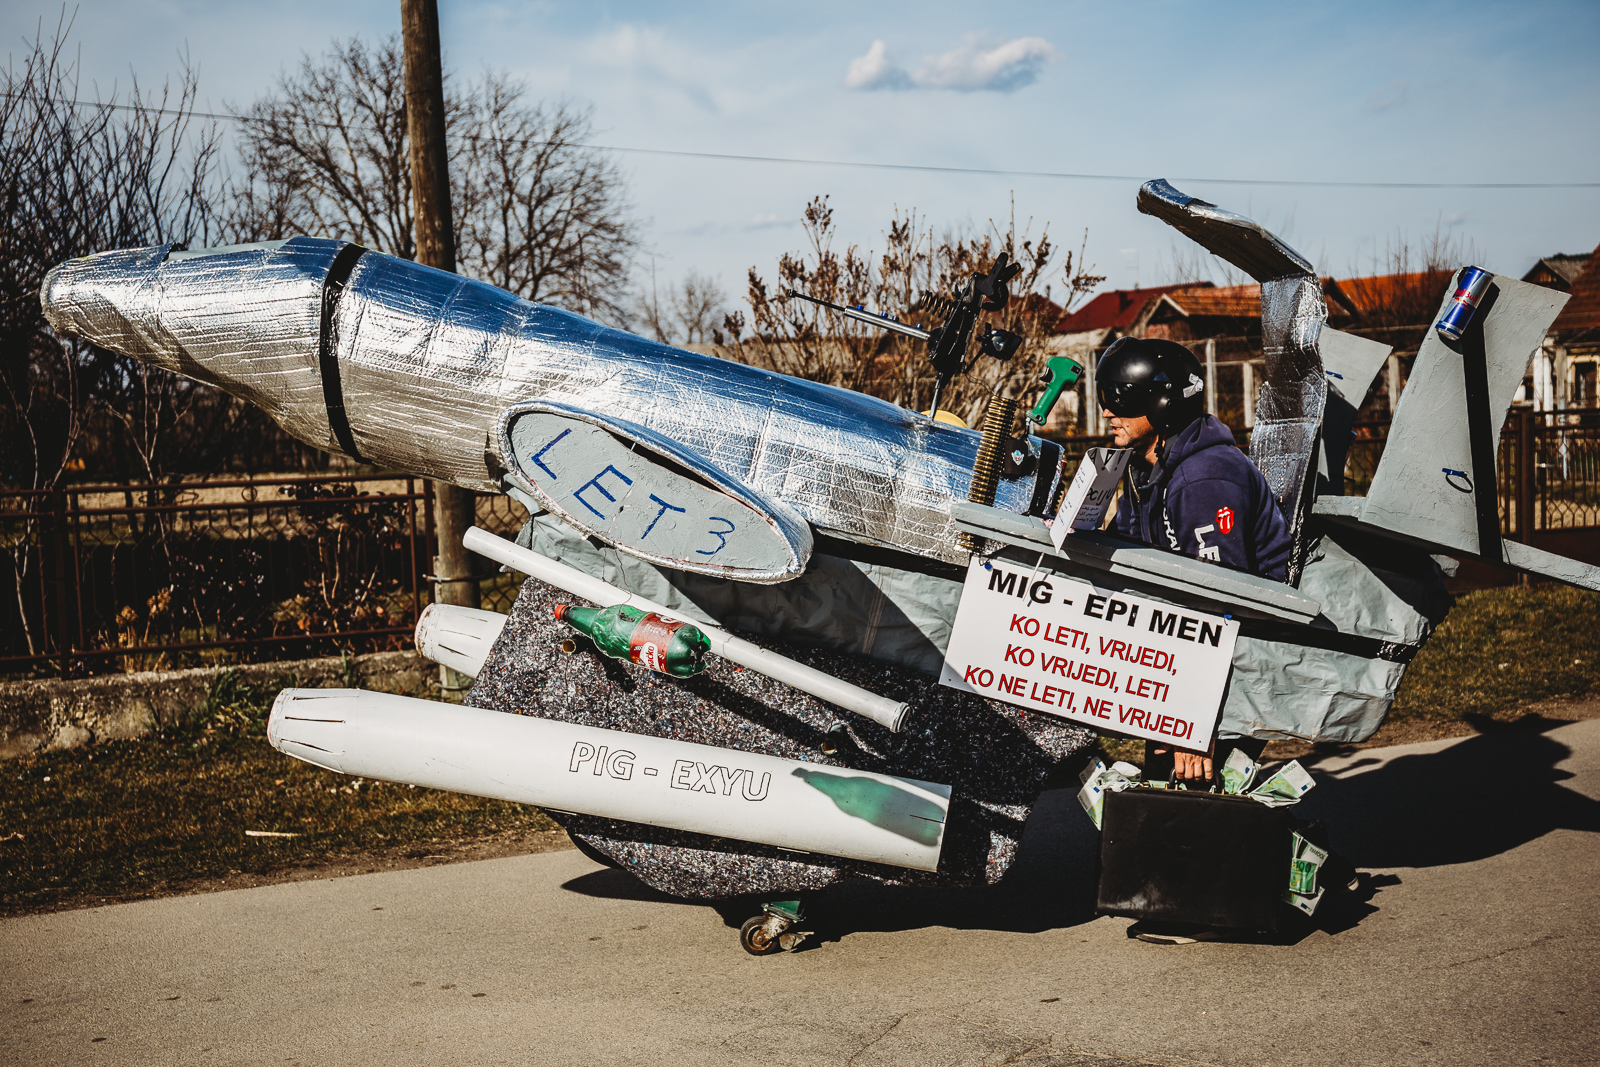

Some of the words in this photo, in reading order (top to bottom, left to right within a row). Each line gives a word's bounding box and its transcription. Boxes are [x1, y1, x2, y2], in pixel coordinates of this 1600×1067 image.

[531, 428, 686, 539] LET
[696, 516, 735, 555] 3
[988, 569, 1053, 605] MIG
[1083, 594, 1140, 627] EPI
[1149, 610, 1223, 648] MEN
[1004, 644, 1035, 667] KO
[1040, 652, 1119, 694] VRIJEDI,
[1125, 676, 1169, 703] LETI
[1009, 613, 1040, 637] KO
[1043, 623, 1091, 655] LETI,
[1099, 636, 1178, 676] VRIJEDI,
[964, 665, 995, 688] KO
[998, 674, 1029, 698] NE
[1030, 683, 1078, 714] LETI,
[1083, 696, 1112, 720] NE
[1118, 704, 1194, 740] VRIJEDI
[568, 741, 637, 781] PIG
[670, 759, 772, 802] EXYU
